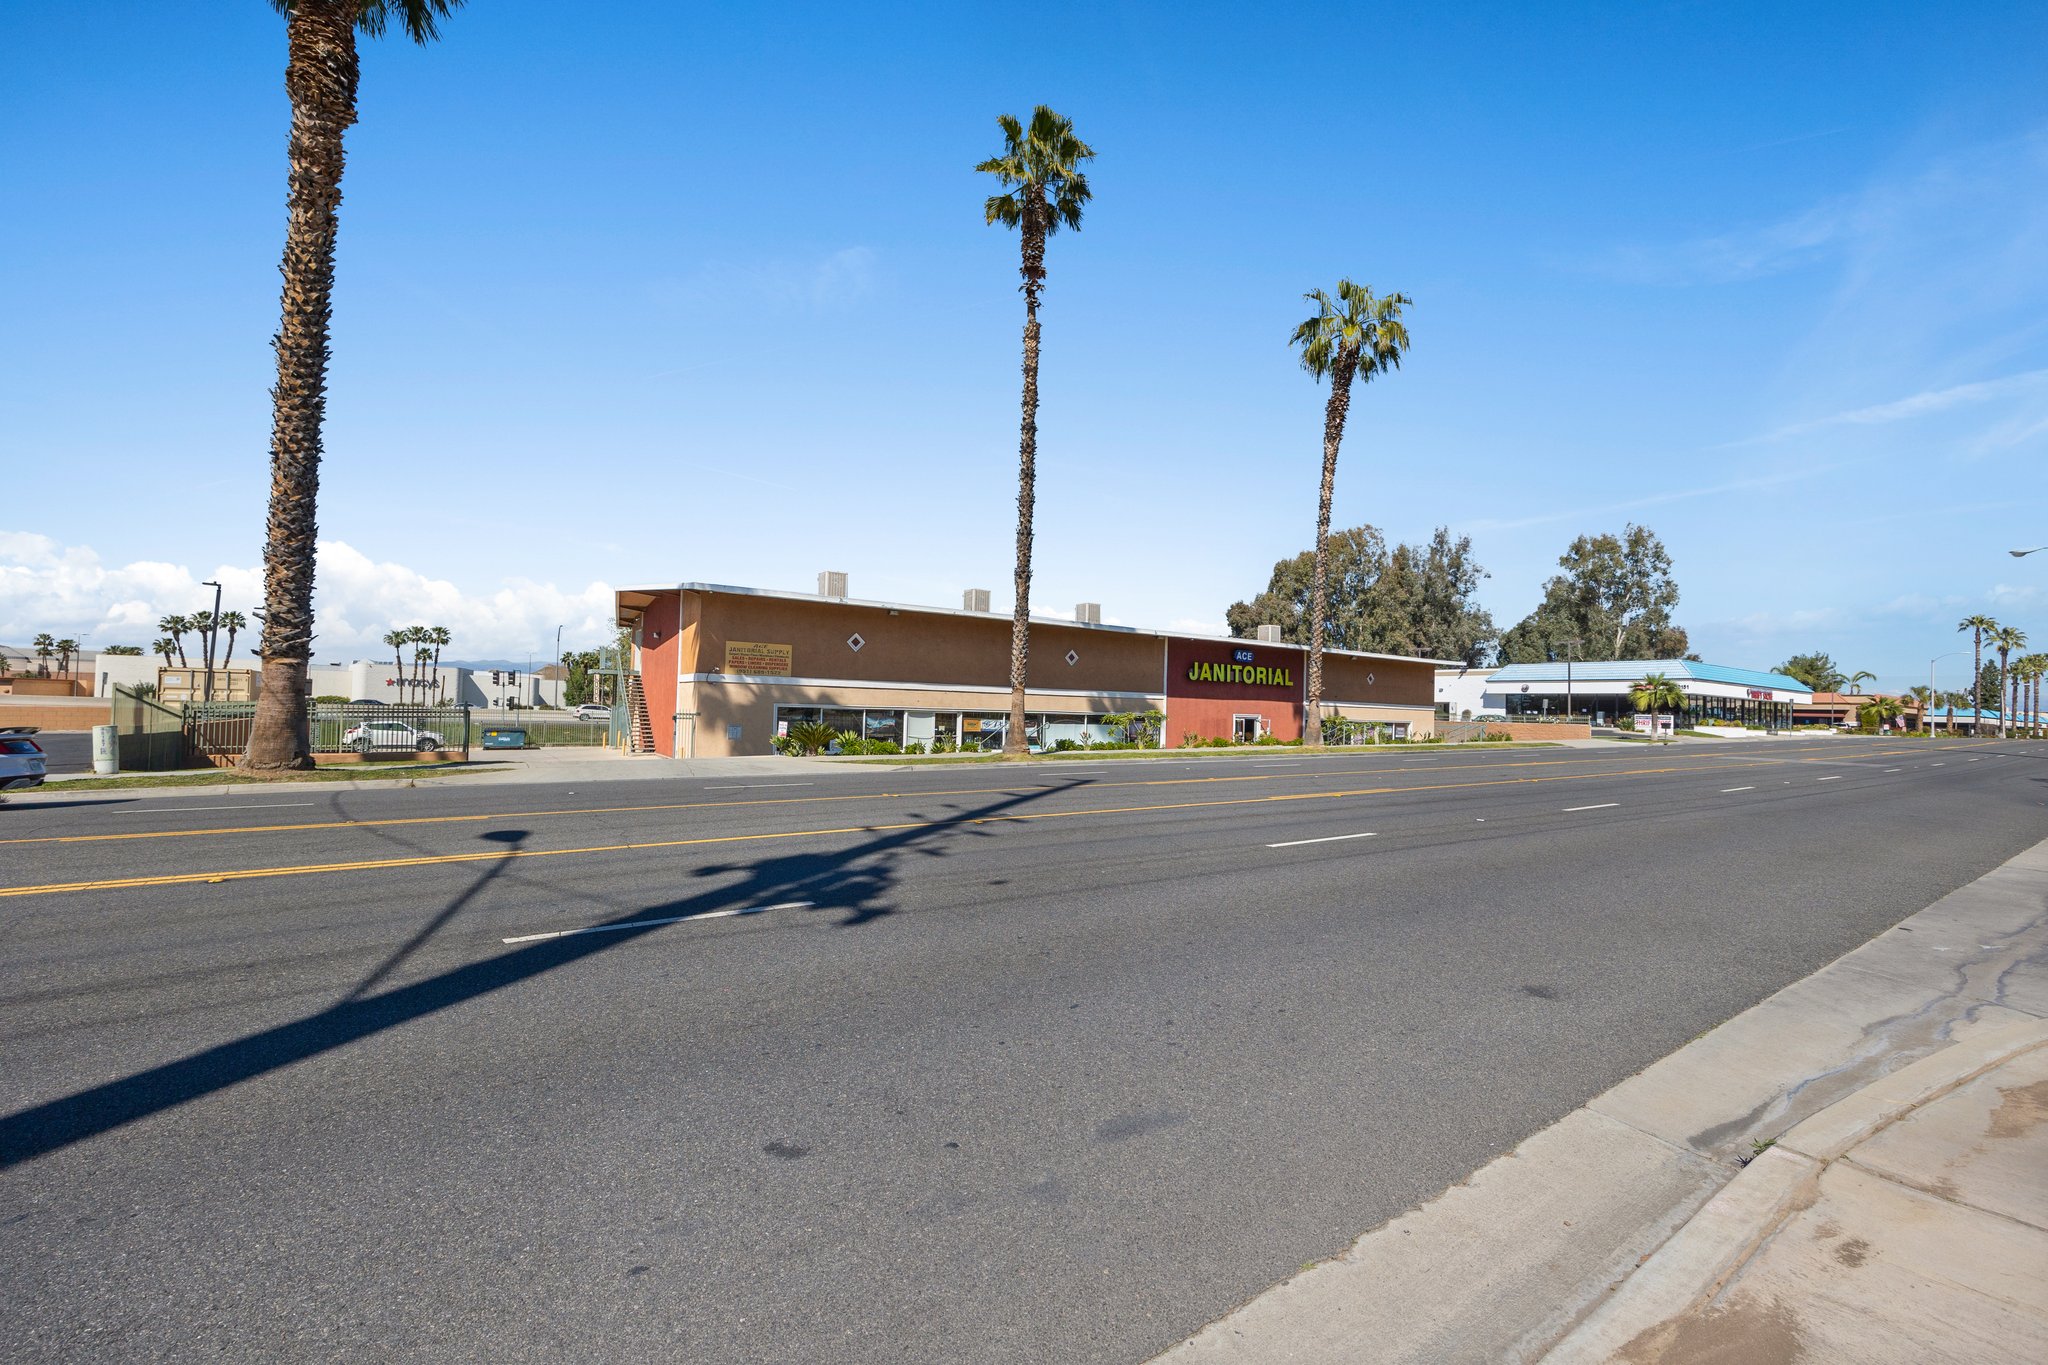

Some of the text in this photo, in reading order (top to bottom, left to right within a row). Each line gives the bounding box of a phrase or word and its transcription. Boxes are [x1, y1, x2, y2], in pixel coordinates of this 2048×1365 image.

[1236, 652, 1253, 661] ACE
[1188, 661, 1294, 687] JANITORIAL
[396, 677, 440, 691] macys
